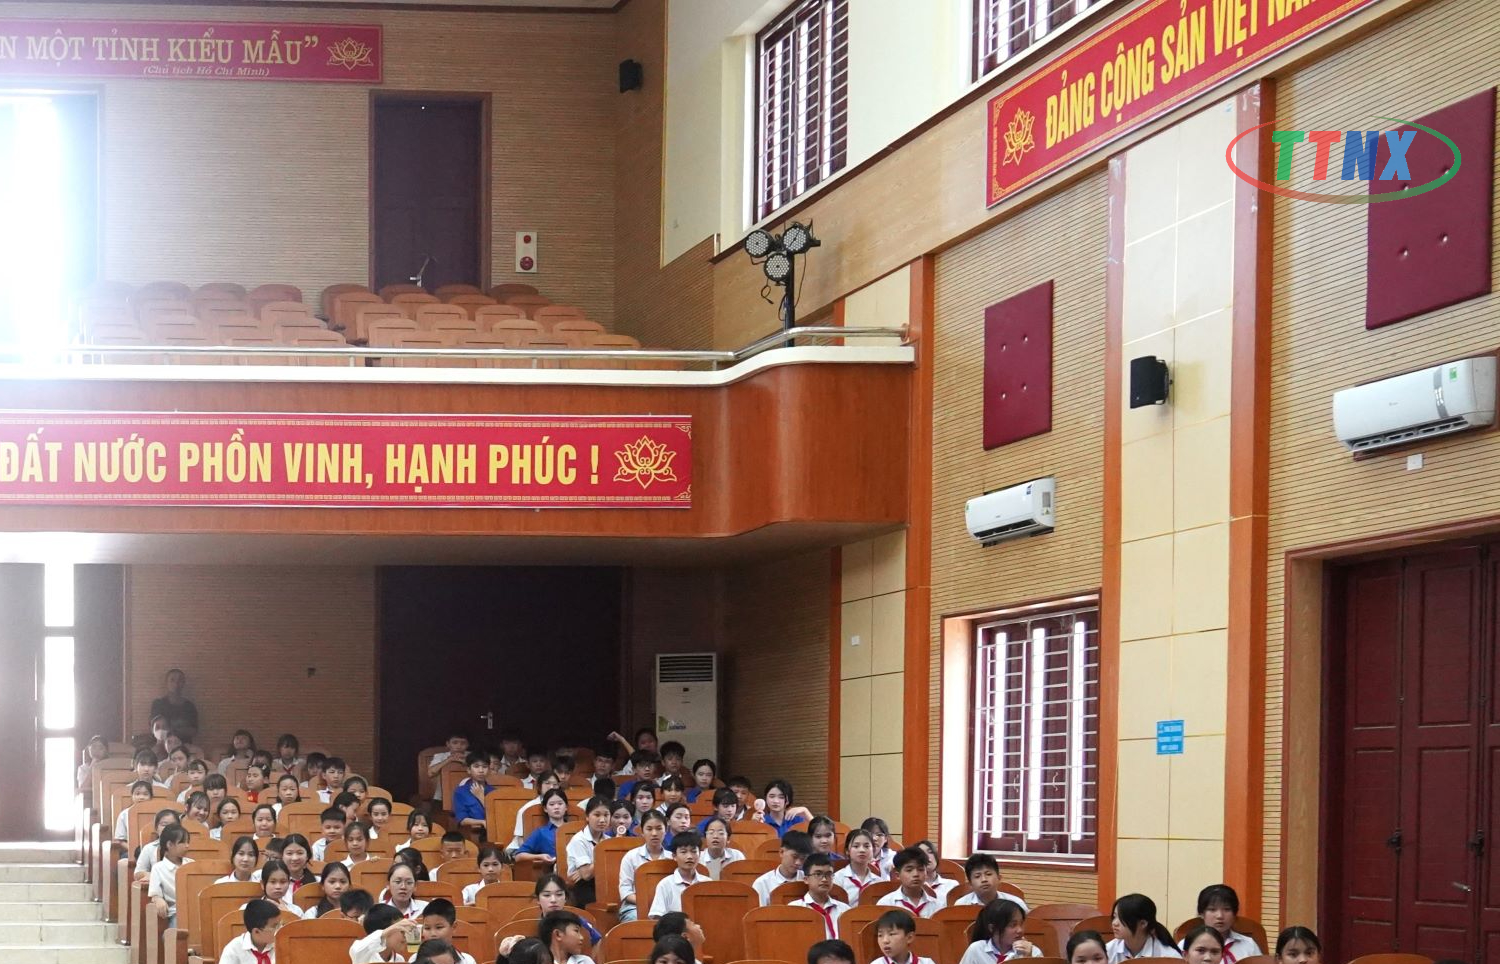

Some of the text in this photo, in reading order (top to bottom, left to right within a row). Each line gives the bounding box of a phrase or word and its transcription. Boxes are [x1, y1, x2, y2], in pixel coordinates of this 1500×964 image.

[25, 28, 85, 67] MỘT
[92, 28, 161, 62] TỈNH
[167, 27, 234, 64] KIỂU
[1046, 69, 1096, 150] ĐẢNG
[1101, 41, 1156, 123] CỘNG
[1160, 0, 1207, 85] SẢN
[74, 433, 167, 483] NƯỚC
[179, 428, 272, 483] PHỒN
[284, 442, 374, 489] VINH,
[386, 443, 477, 493] HẠNH
[488, 436, 578, 485] PHÚC
[590, 445, 599, 485] !
